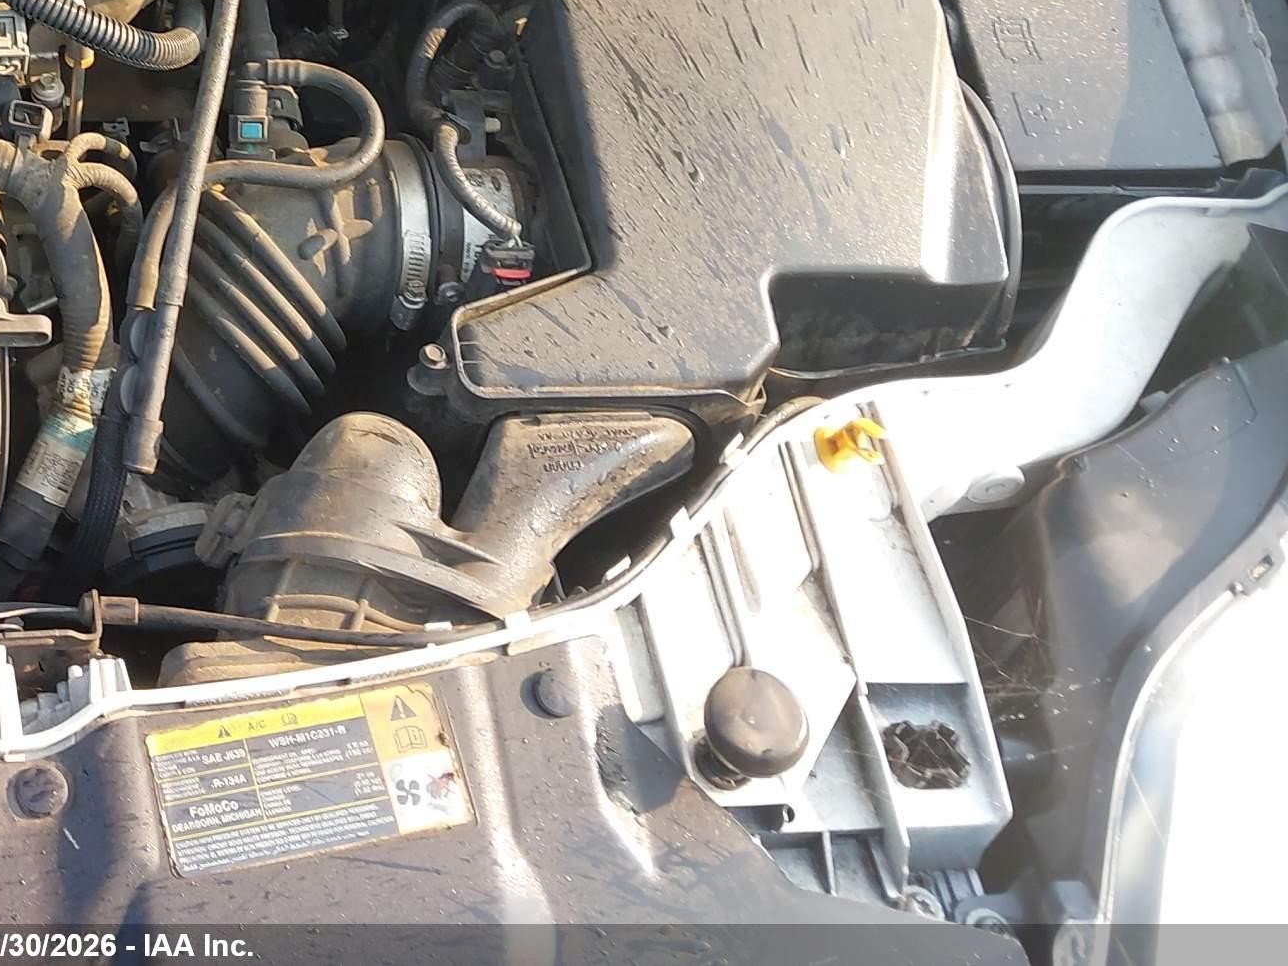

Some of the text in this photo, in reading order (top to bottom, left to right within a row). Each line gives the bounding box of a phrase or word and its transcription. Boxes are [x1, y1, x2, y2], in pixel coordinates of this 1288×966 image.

[201, 753, 223, 766] SAE
[223, 748, 246, 762] J639
[189, 799, 239, 819] FoMoCo
[222, 808, 262, 826] MICHIGAN
